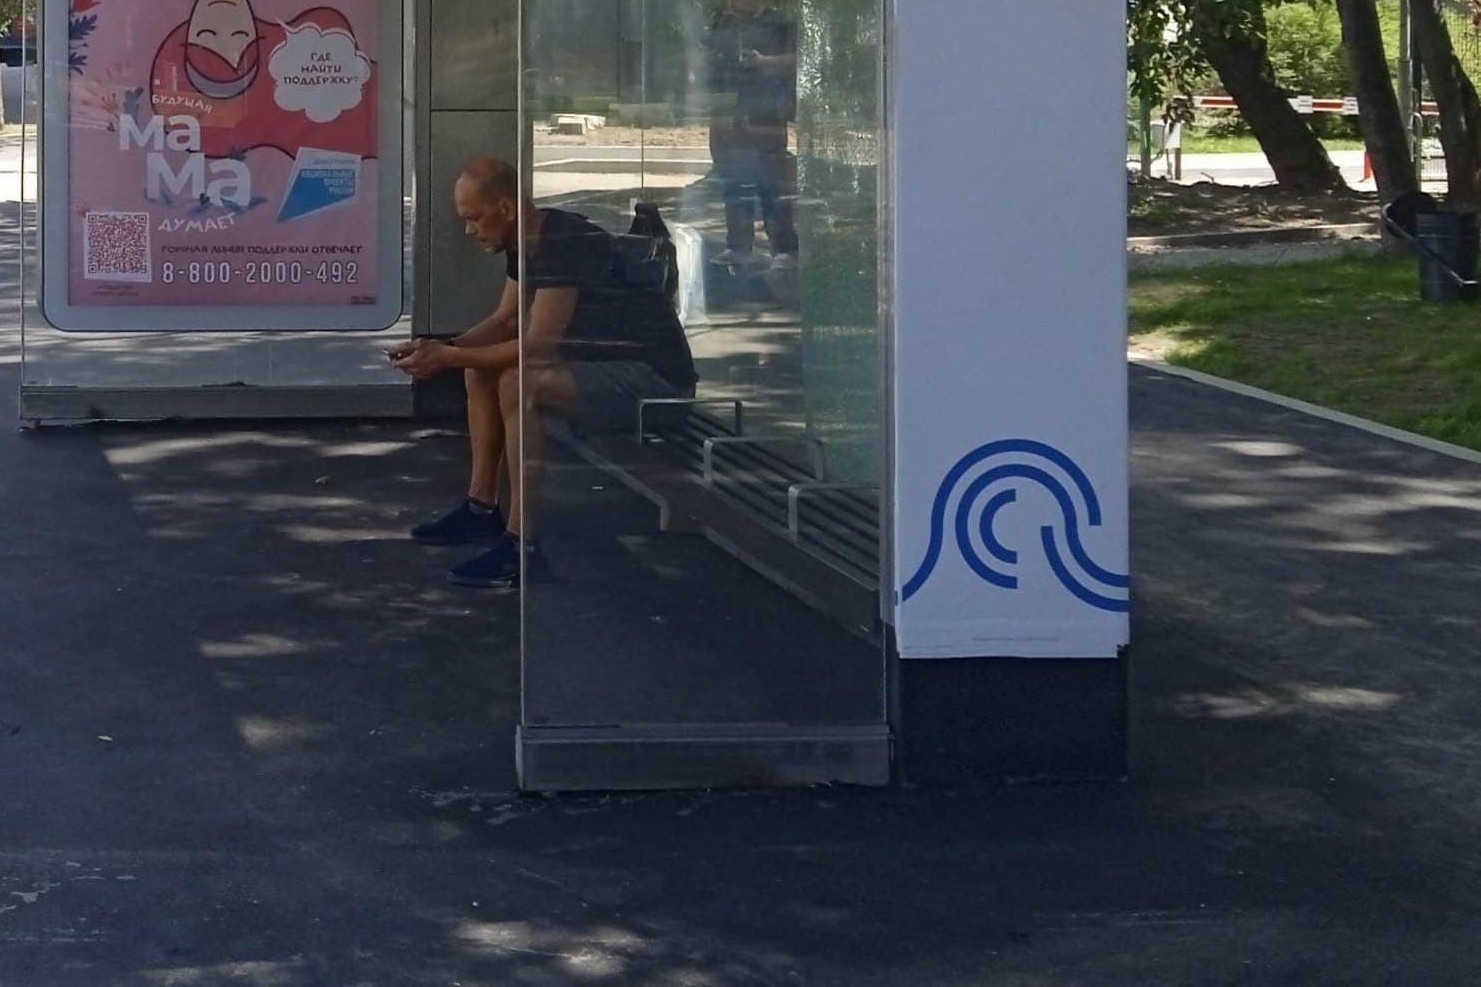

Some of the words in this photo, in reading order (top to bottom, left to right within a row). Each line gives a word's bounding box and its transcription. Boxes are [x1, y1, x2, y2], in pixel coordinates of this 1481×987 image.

[310, 52, 332, 62] ГДЕ
[152, 94, 213, 113] БУДУЩАЯ
[158, 212, 236, 233] ДУМАЕТ
[162, 262, 359, 284] 8-800-2000-492
